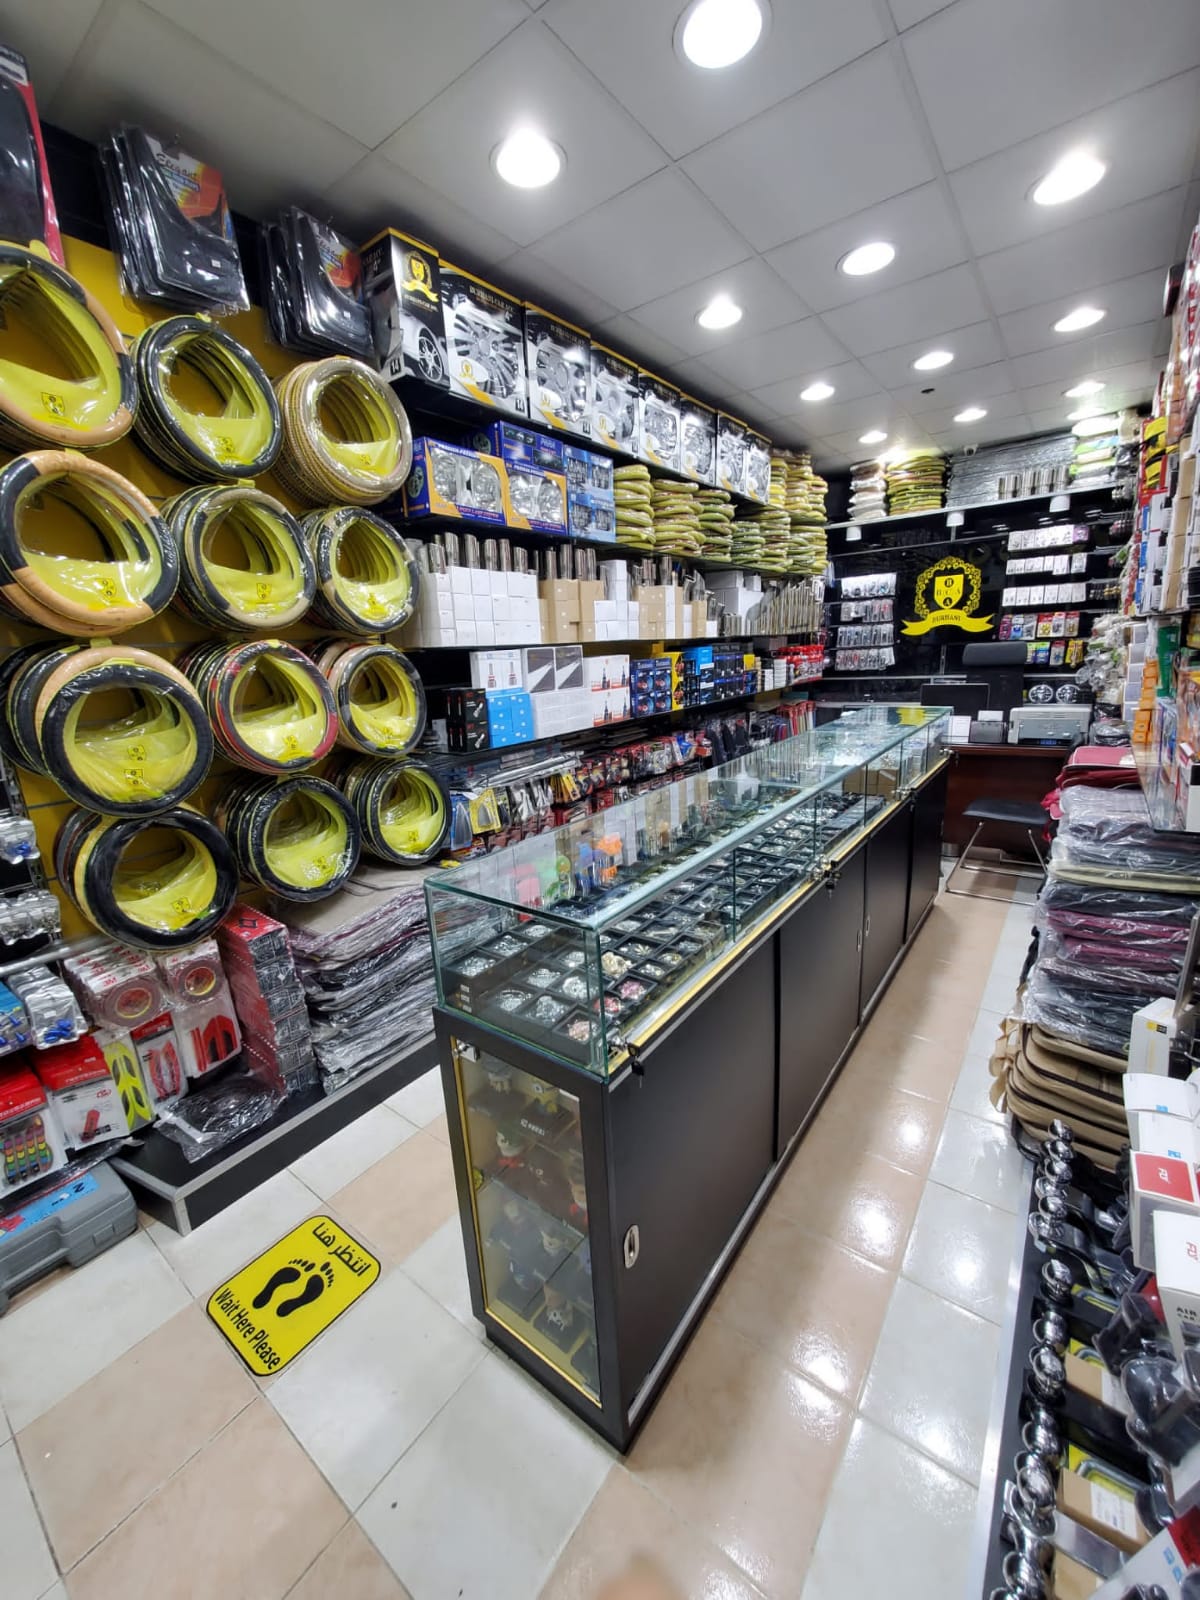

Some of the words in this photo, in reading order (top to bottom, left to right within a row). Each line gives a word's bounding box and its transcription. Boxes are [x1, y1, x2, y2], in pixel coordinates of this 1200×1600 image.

[391, 360, 400, 374] 14
[312, 1222, 336, 1248] هنا
[328, 1245, 371, 1277] انتظر
[215, 1288, 240, 1317] Wait
[231, 1310, 256, 1338] Here
[250, 1329, 281, 1370] Please
